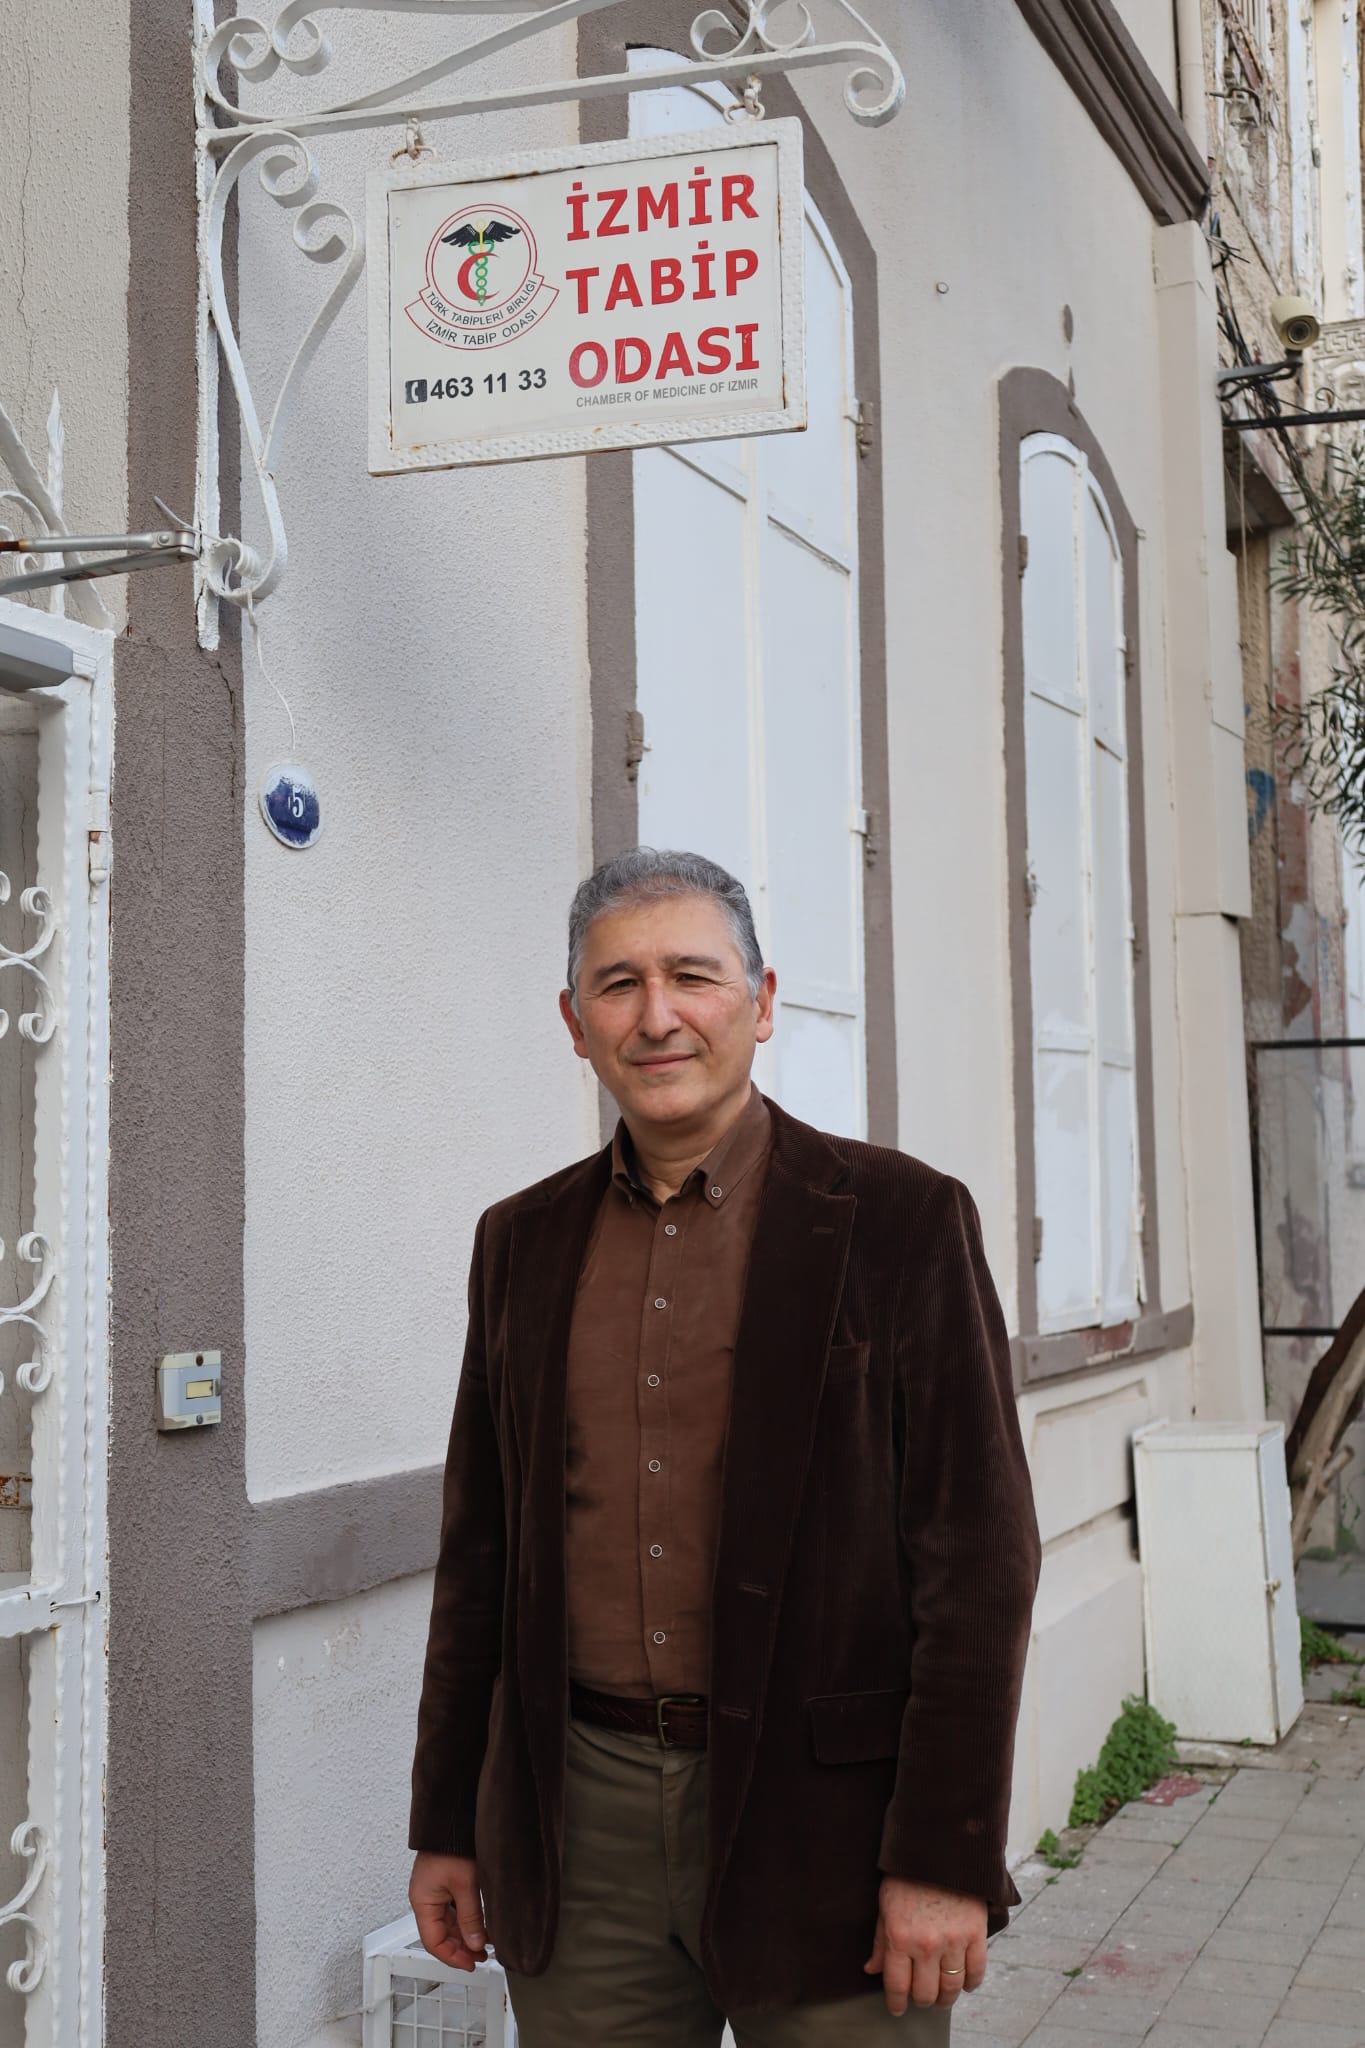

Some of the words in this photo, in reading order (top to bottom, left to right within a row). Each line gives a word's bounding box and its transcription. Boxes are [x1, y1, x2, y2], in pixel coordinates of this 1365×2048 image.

[566, 166, 759, 242] İZMİR
[565, 241, 759, 314] TABİP
[425, 319, 458, 343] İZMİR
[463, 332, 498, 345] TABİP
[502, 309, 539, 339] ODASI
[568, 323, 760, 389] ODASI
[430, 376, 475, 400] 463
[483, 373, 507, 395] 11
[518, 368, 548, 391] 33
[576, 392, 632, 408] CHAMBER
[634, 389, 650, 402] OF
[652, 383, 707, 400] MEDICINE
[709, 381, 726, 394] OF
[728, 378, 760, 392] IZMIR
